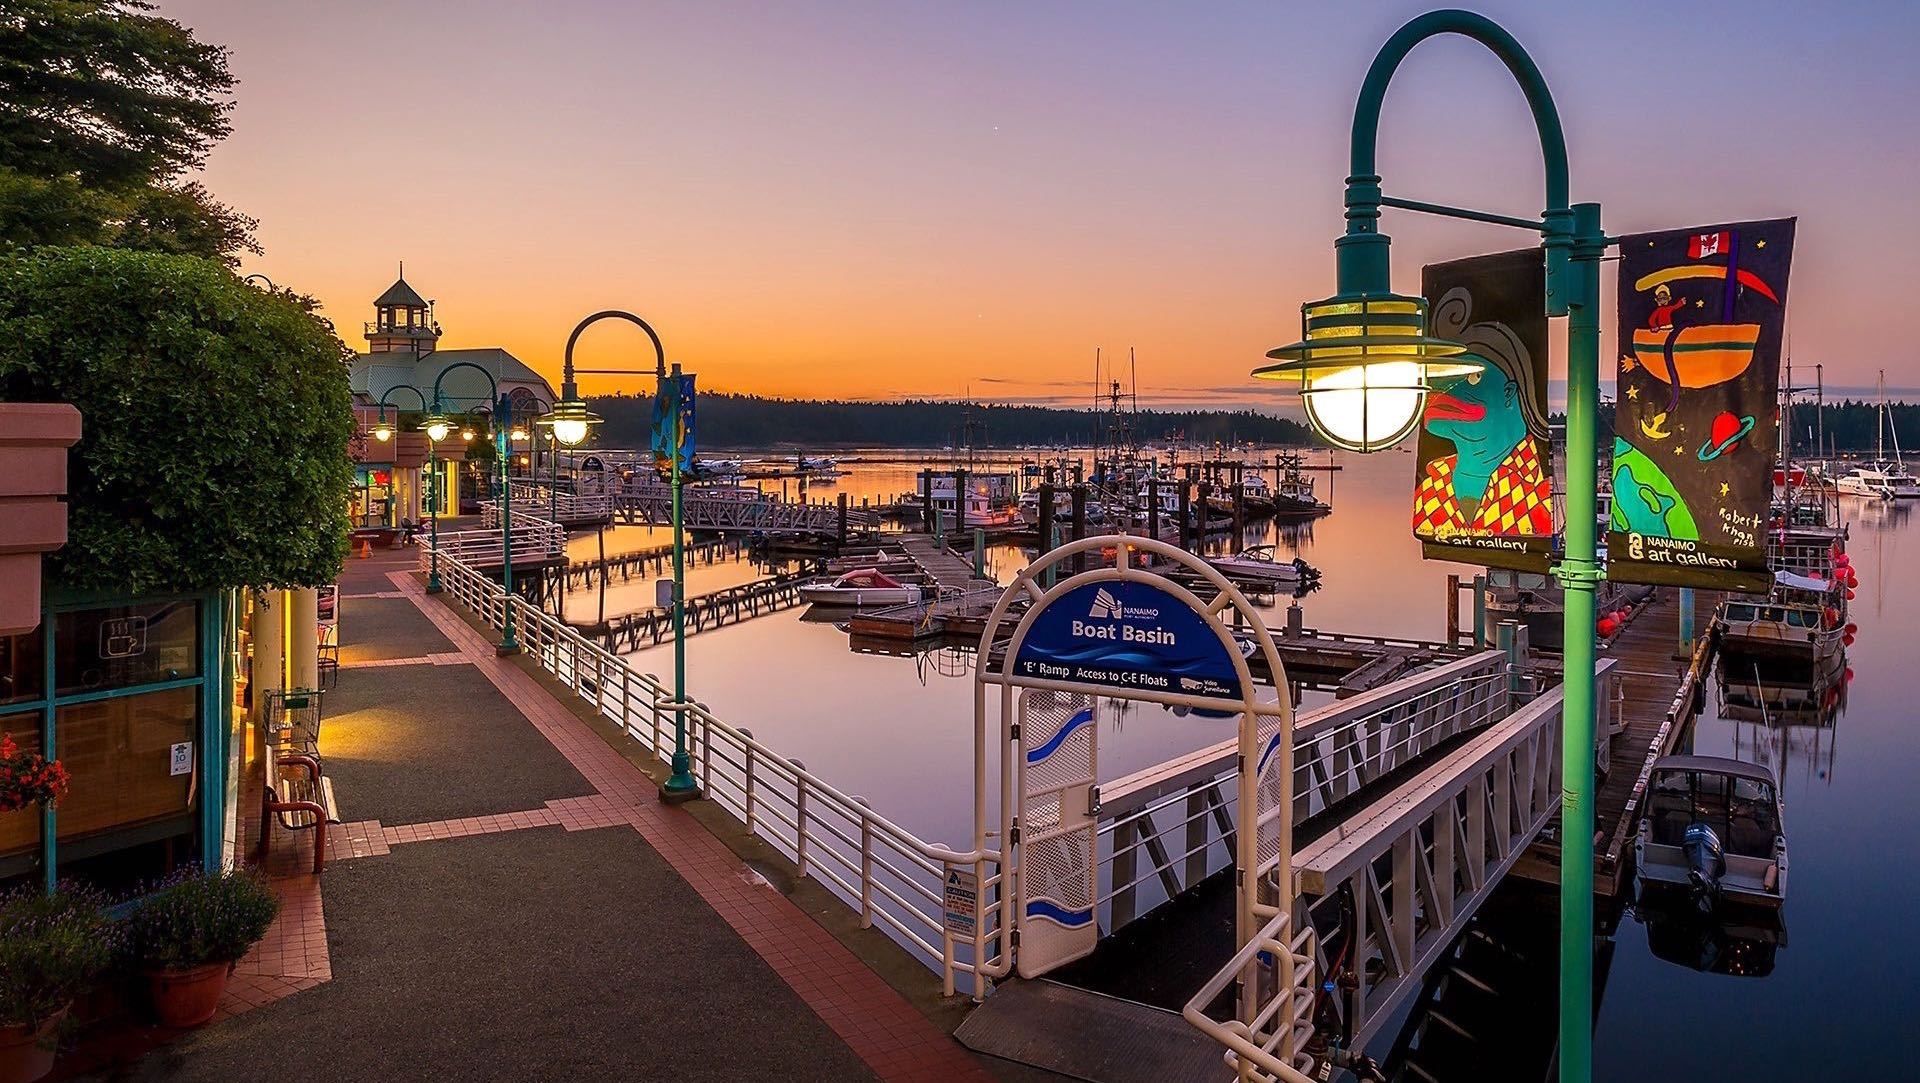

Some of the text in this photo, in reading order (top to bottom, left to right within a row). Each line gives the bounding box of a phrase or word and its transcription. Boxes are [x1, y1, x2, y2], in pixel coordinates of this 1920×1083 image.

[1718, 507, 1762, 529] Robert
[1452, 536, 1472, 546] art
[1647, 536, 1696, 552] NANAIMO
[1648, 548, 1737, 569] art gallery
[1123, 607, 1159, 617] NANAIMO
[1072, 620, 1176, 645] Boat Basin
[1039, 662, 1070, 678] Ramp
[1076, 667, 1107, 680] Access
[1109, 671, 1119, 682] to
[1121, 672, 1137, 684] C-E
[1139, 673, 1168, 687] Floats
